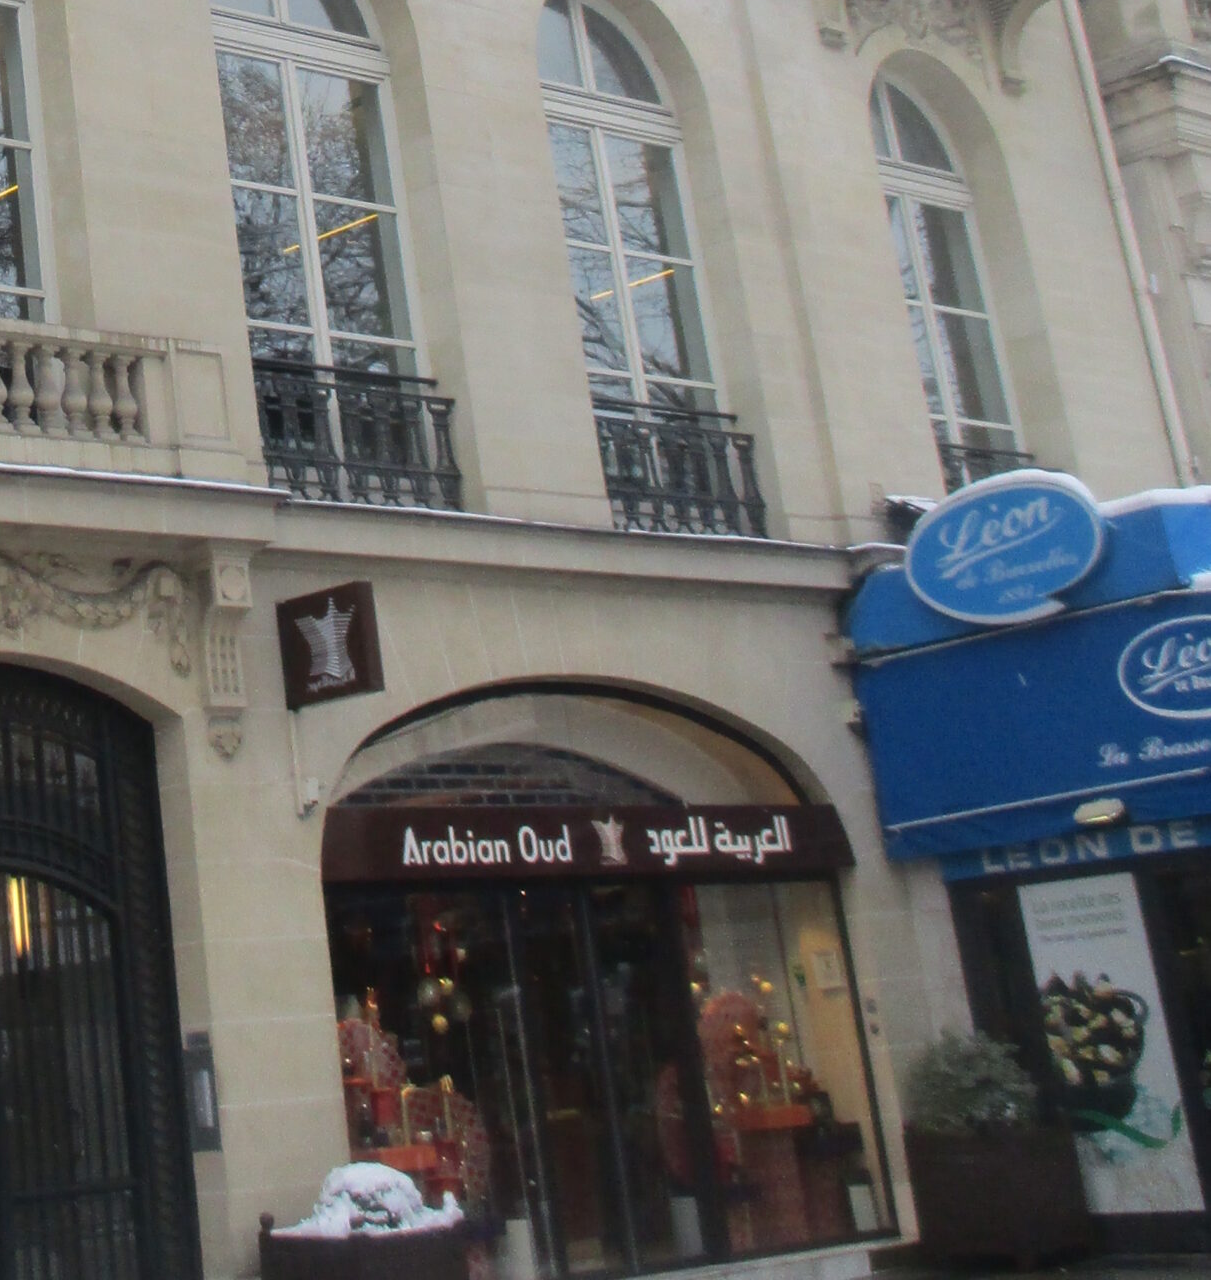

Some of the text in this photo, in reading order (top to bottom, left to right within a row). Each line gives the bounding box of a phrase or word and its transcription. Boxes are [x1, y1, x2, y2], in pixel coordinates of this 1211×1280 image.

[1141, 632, 1211, 690] Léo
[402, 824, 573, 866] Arabian Oud
[647, 816, 791, 866] العربية للعود
[1128, 822, 1198, 855] DE
